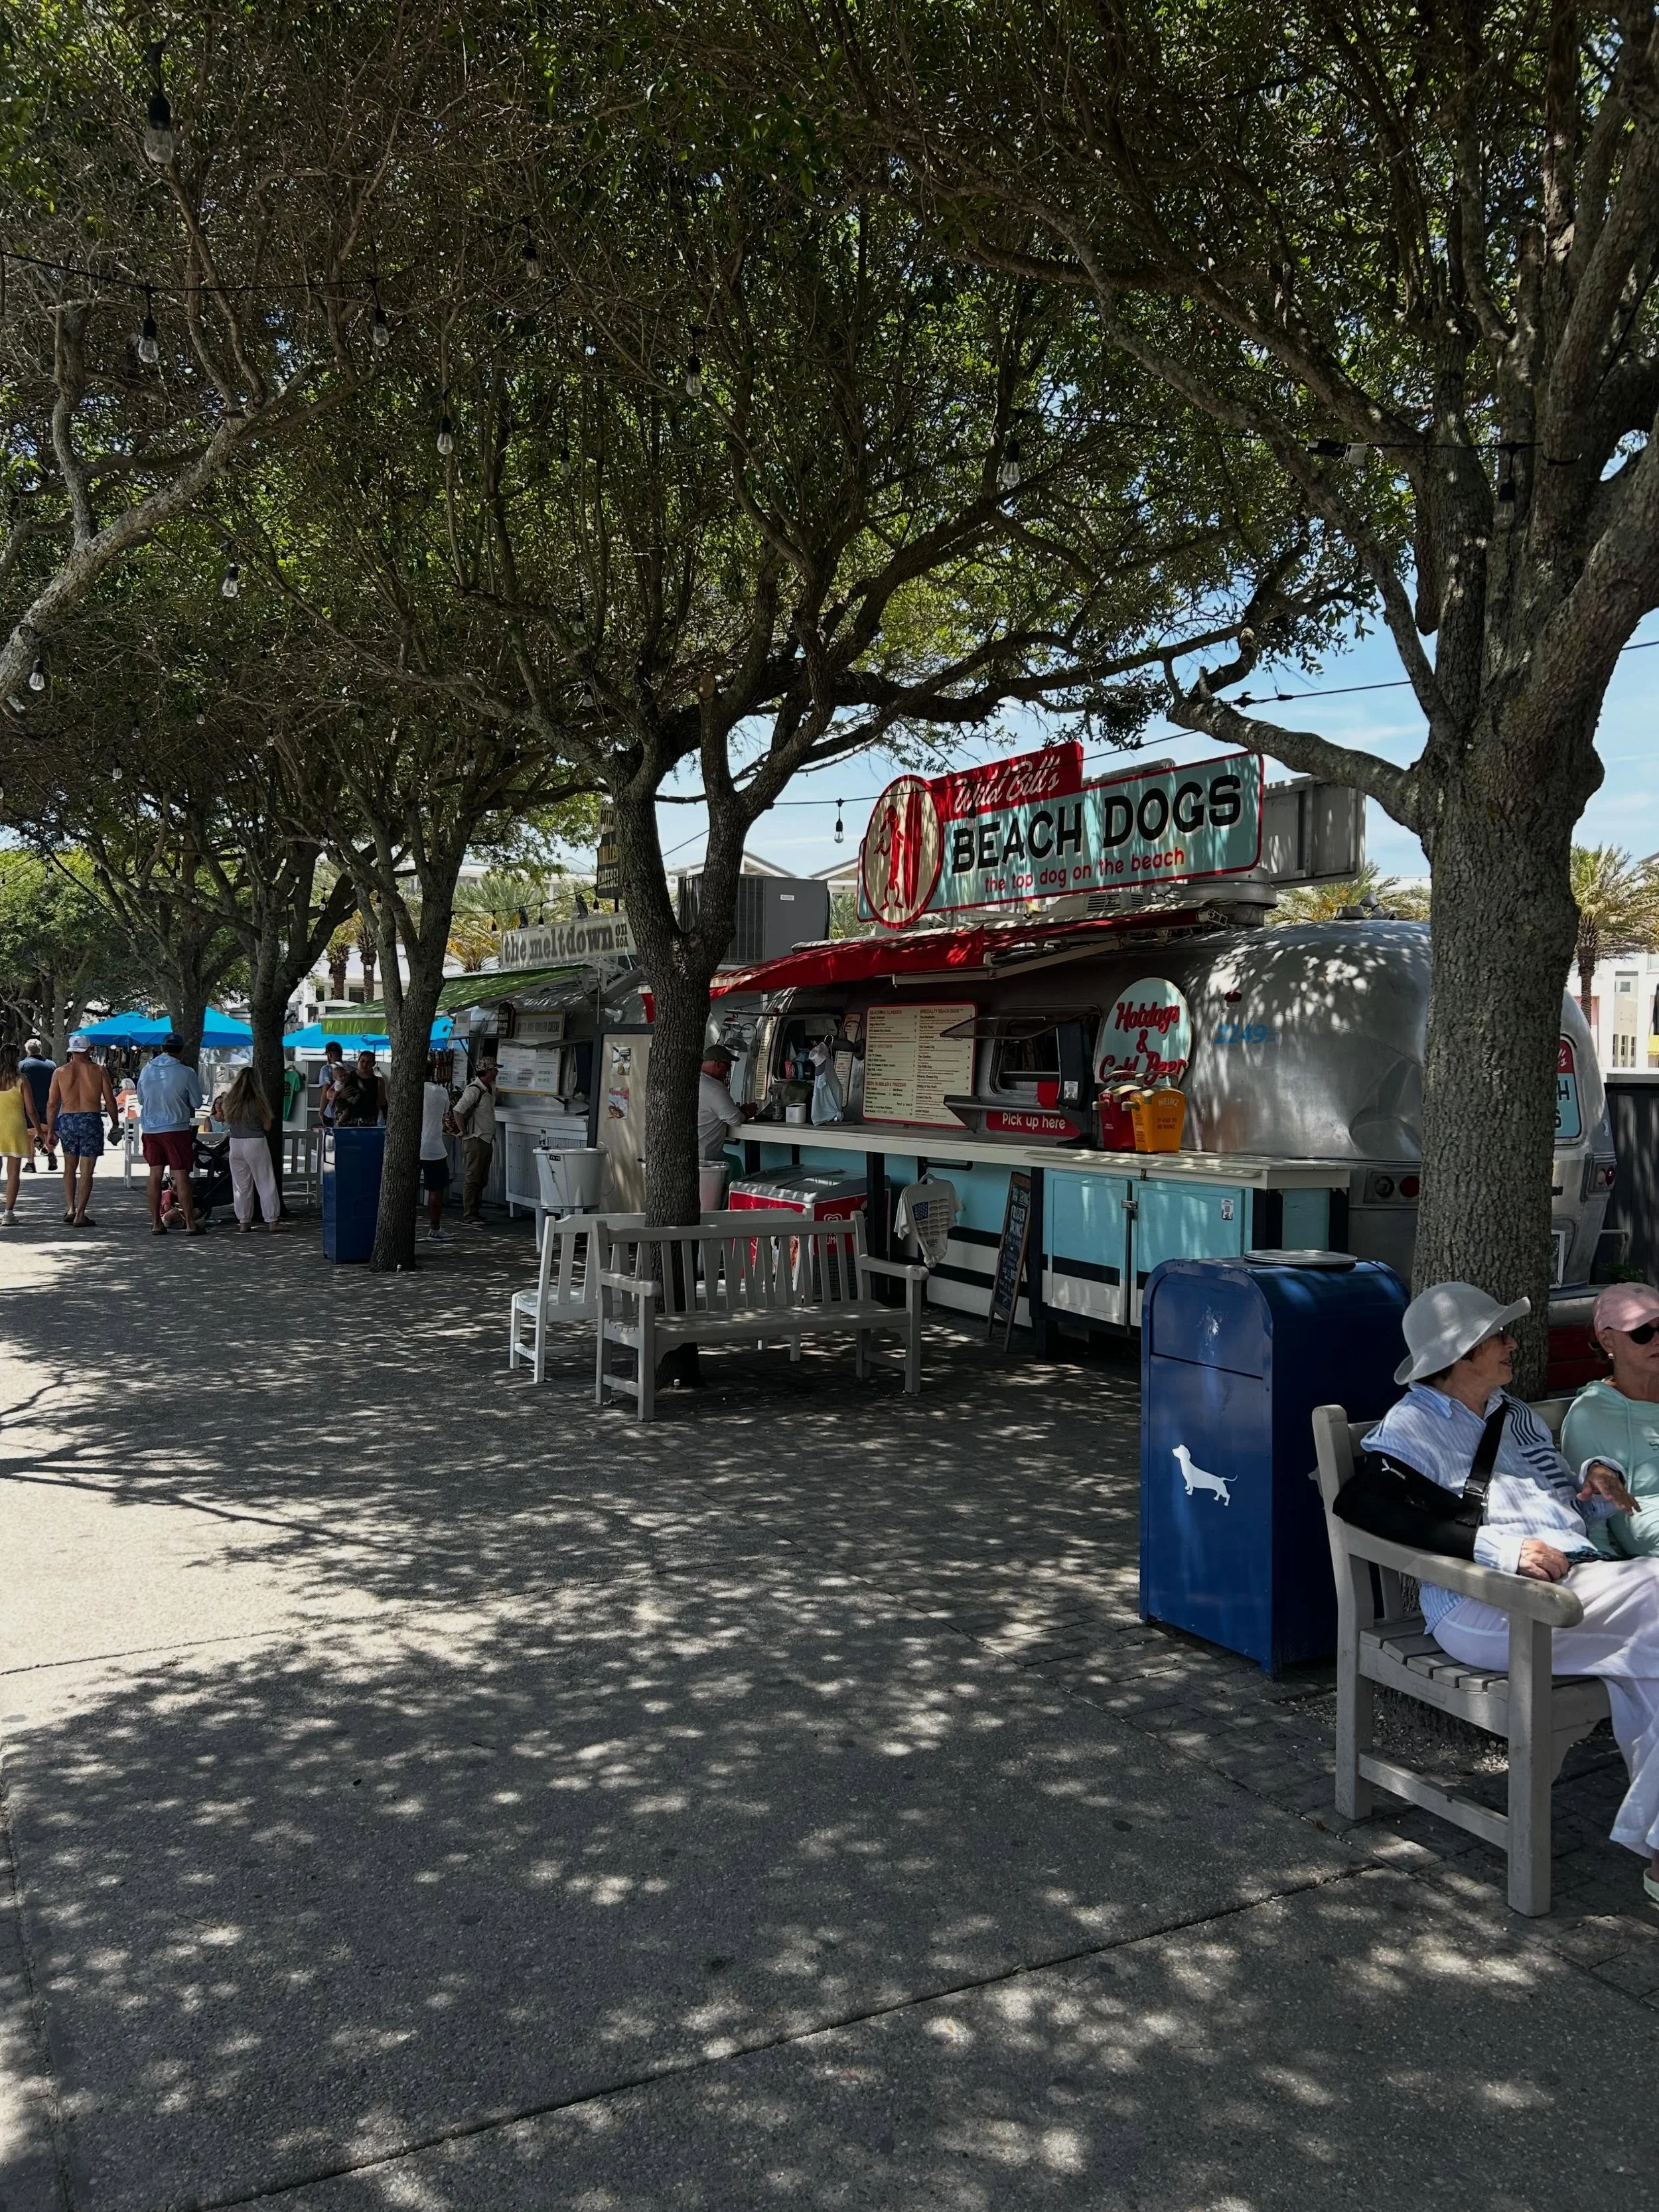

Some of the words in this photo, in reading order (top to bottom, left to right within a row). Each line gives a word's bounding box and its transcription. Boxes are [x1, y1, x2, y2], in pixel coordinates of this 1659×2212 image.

[954, 766, 1011, 814] Wild
[1005, 755, 1060, 800] Bill's
[952, 803, 1082, 875] BEACH
[1102, 774, 1243, 849] DOGS
[984, 875, 1007, 894] the
[1011, 870, 1034, 891] top
[1039, 865, 1068, 889] dog
[1072, 865, 1092, 880] on
[1098, 857, 1124, 877] the
[1131, 846, 1185, 870] beach
[504, 934, 527, 962] the
[529, 924, 615, 960] meltdown
[1114, 1001, 1180, 1034] Hotdogs
[1135, 1029, 1148, 1054] &
[1099, 1054, 1139, 1084] Cold
[1143, 1049, 1189, 1085] Beer
[1157, 1096, 1181, 1107] HEINZ
[1001, 1112, 1022, 1126] Pick
[1025, 1116, 1040, 1130] up
[1042, 1114, 1066, 1130] here
